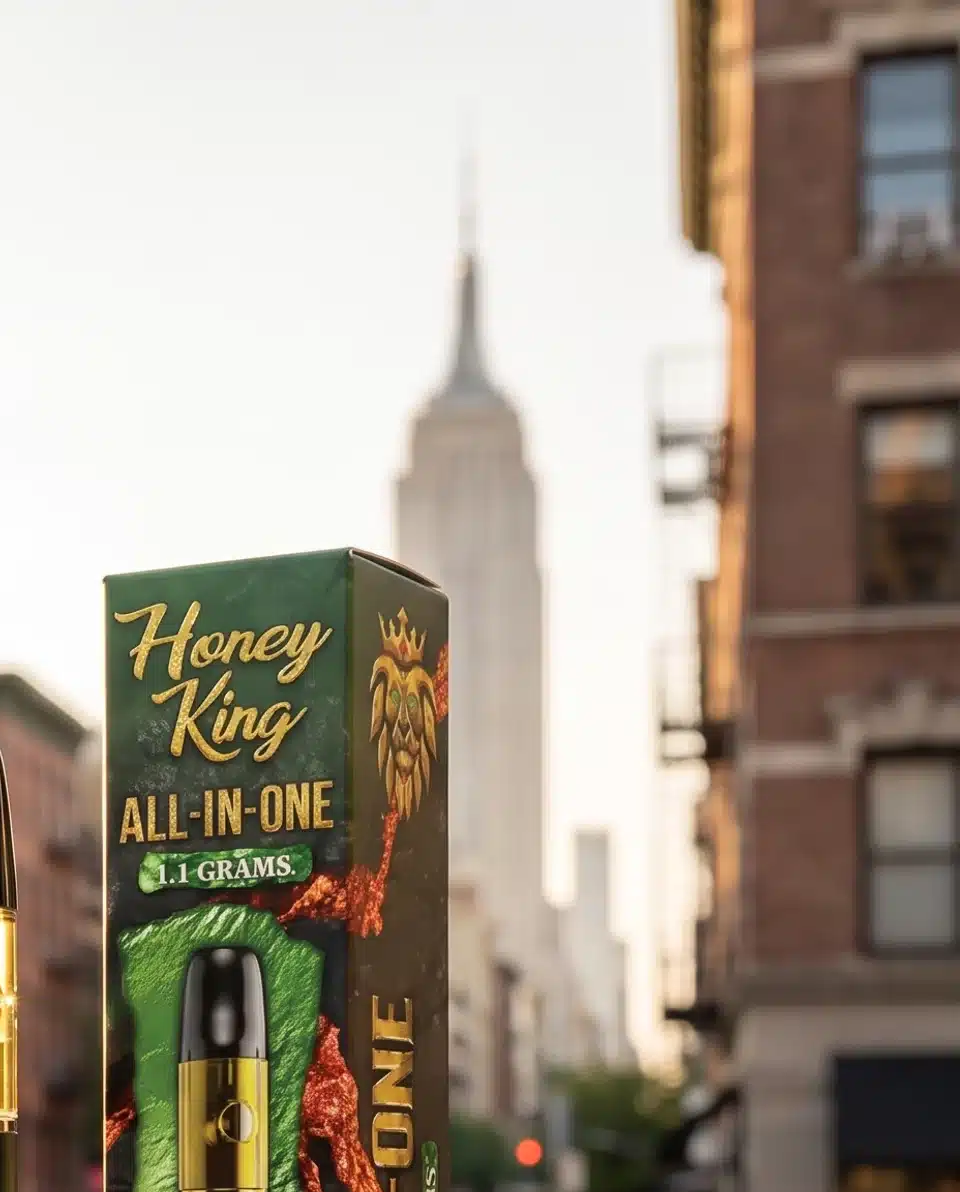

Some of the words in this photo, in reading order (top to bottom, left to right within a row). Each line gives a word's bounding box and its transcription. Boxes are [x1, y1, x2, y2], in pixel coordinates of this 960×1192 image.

[113, 600, 333, 684] Honey
[151, 670, 308, 763] King
[119, 780, 335, 844] ALL-IN-ONE
[159, 863, 189, 885] 1.1
[197, 854, 296, 882] GRAMS.
